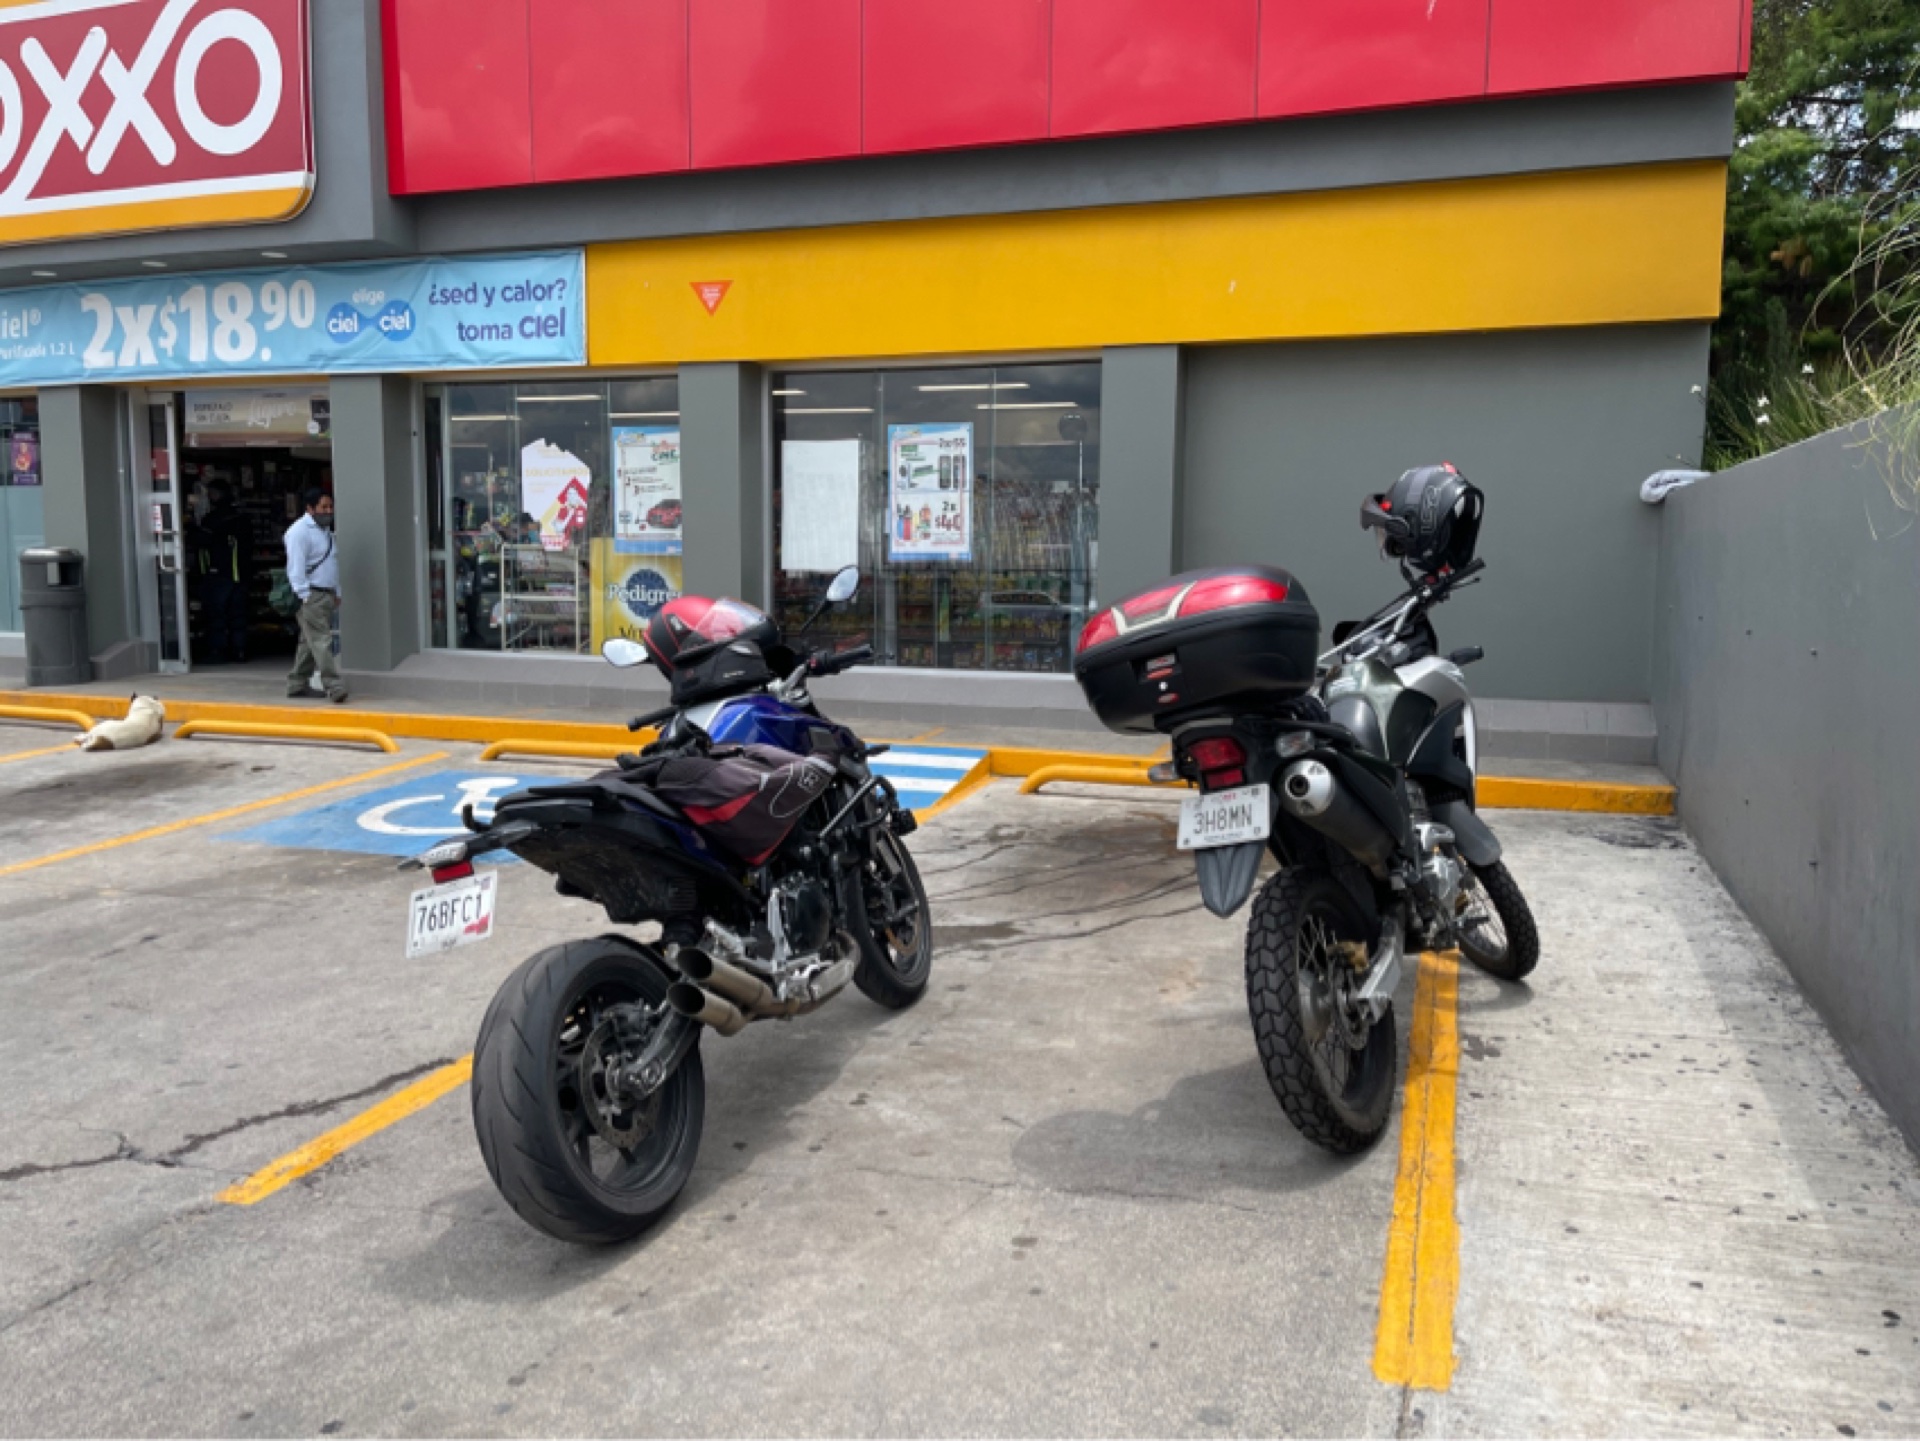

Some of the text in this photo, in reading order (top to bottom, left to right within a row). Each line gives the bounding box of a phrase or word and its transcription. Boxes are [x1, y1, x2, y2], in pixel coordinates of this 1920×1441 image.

[0, 0, 282, 196] XXO
[428, 278, 567, 308] ¿sed y calor?
[328, 309, 409, 334] ciel ciel
[457, 321, 513, 341] toma
[69, 341, 75, 355] L
